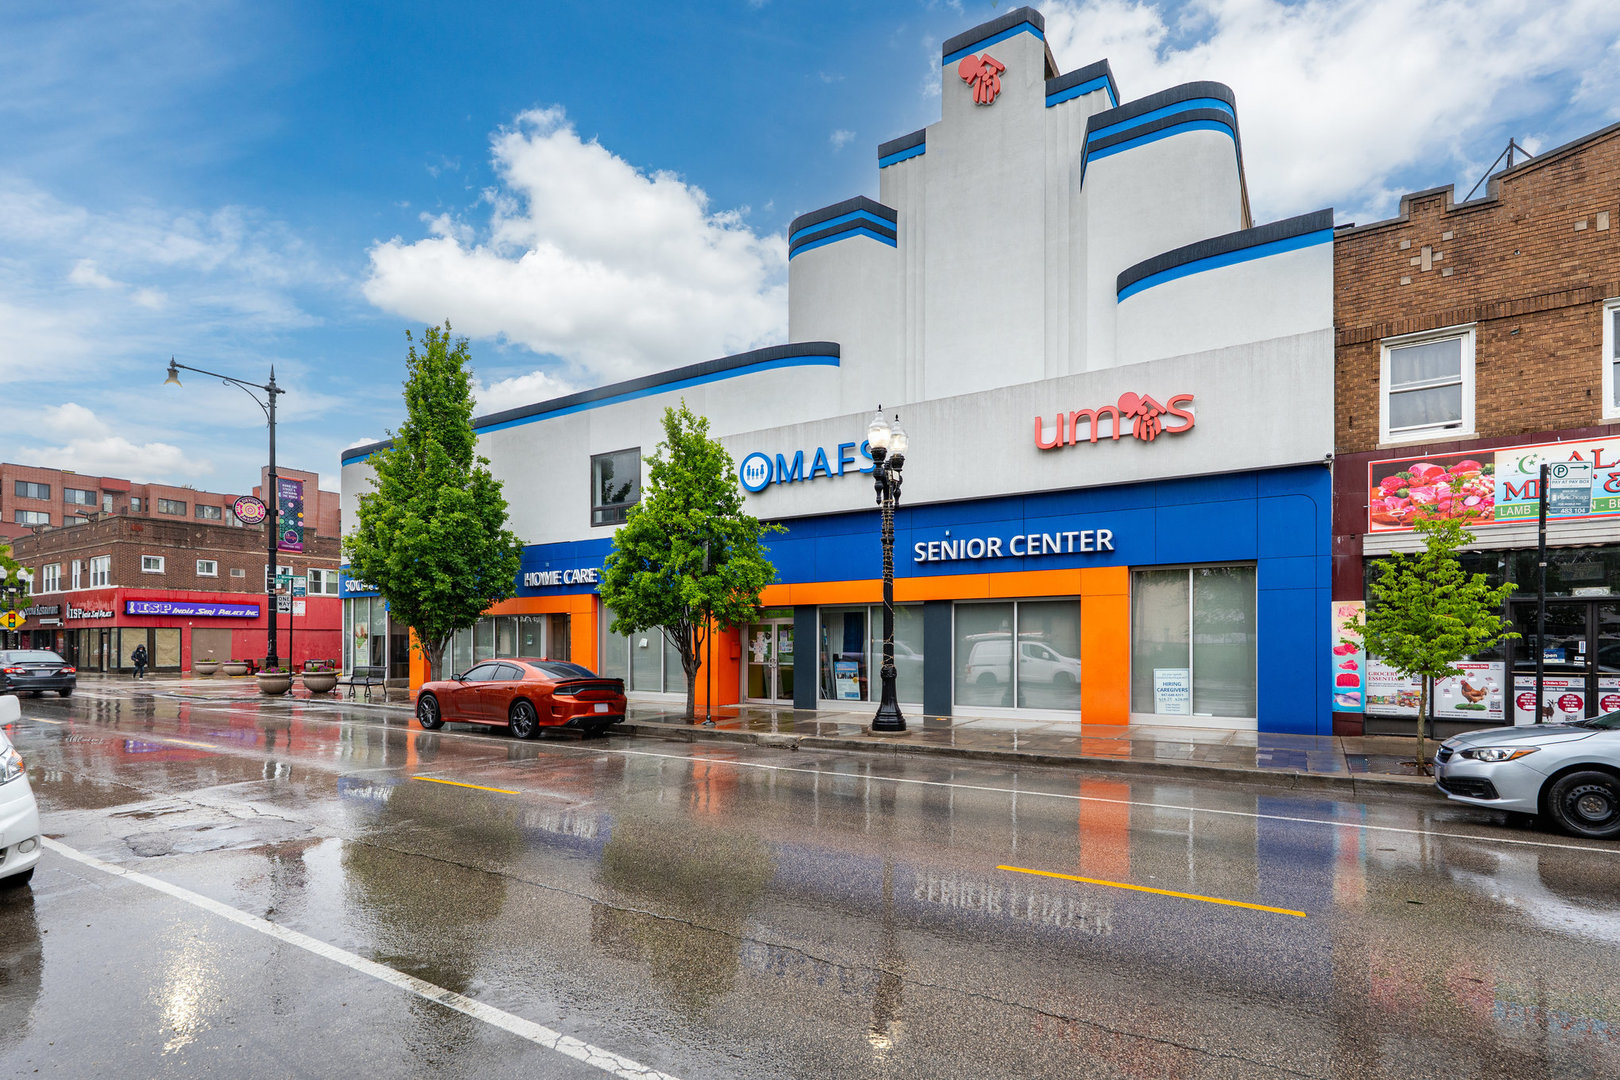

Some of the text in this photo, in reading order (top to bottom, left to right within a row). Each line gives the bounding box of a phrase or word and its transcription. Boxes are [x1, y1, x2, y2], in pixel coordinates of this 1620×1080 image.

[1500, 504, 1531, 517] LAMB
[914, 529, 1115, 562] SENIOR CENTER
[524, 568, 598, 587] HOME CARE
[70, 608, 82, 619] ISP
[137, 602, 172, 614] ISP
